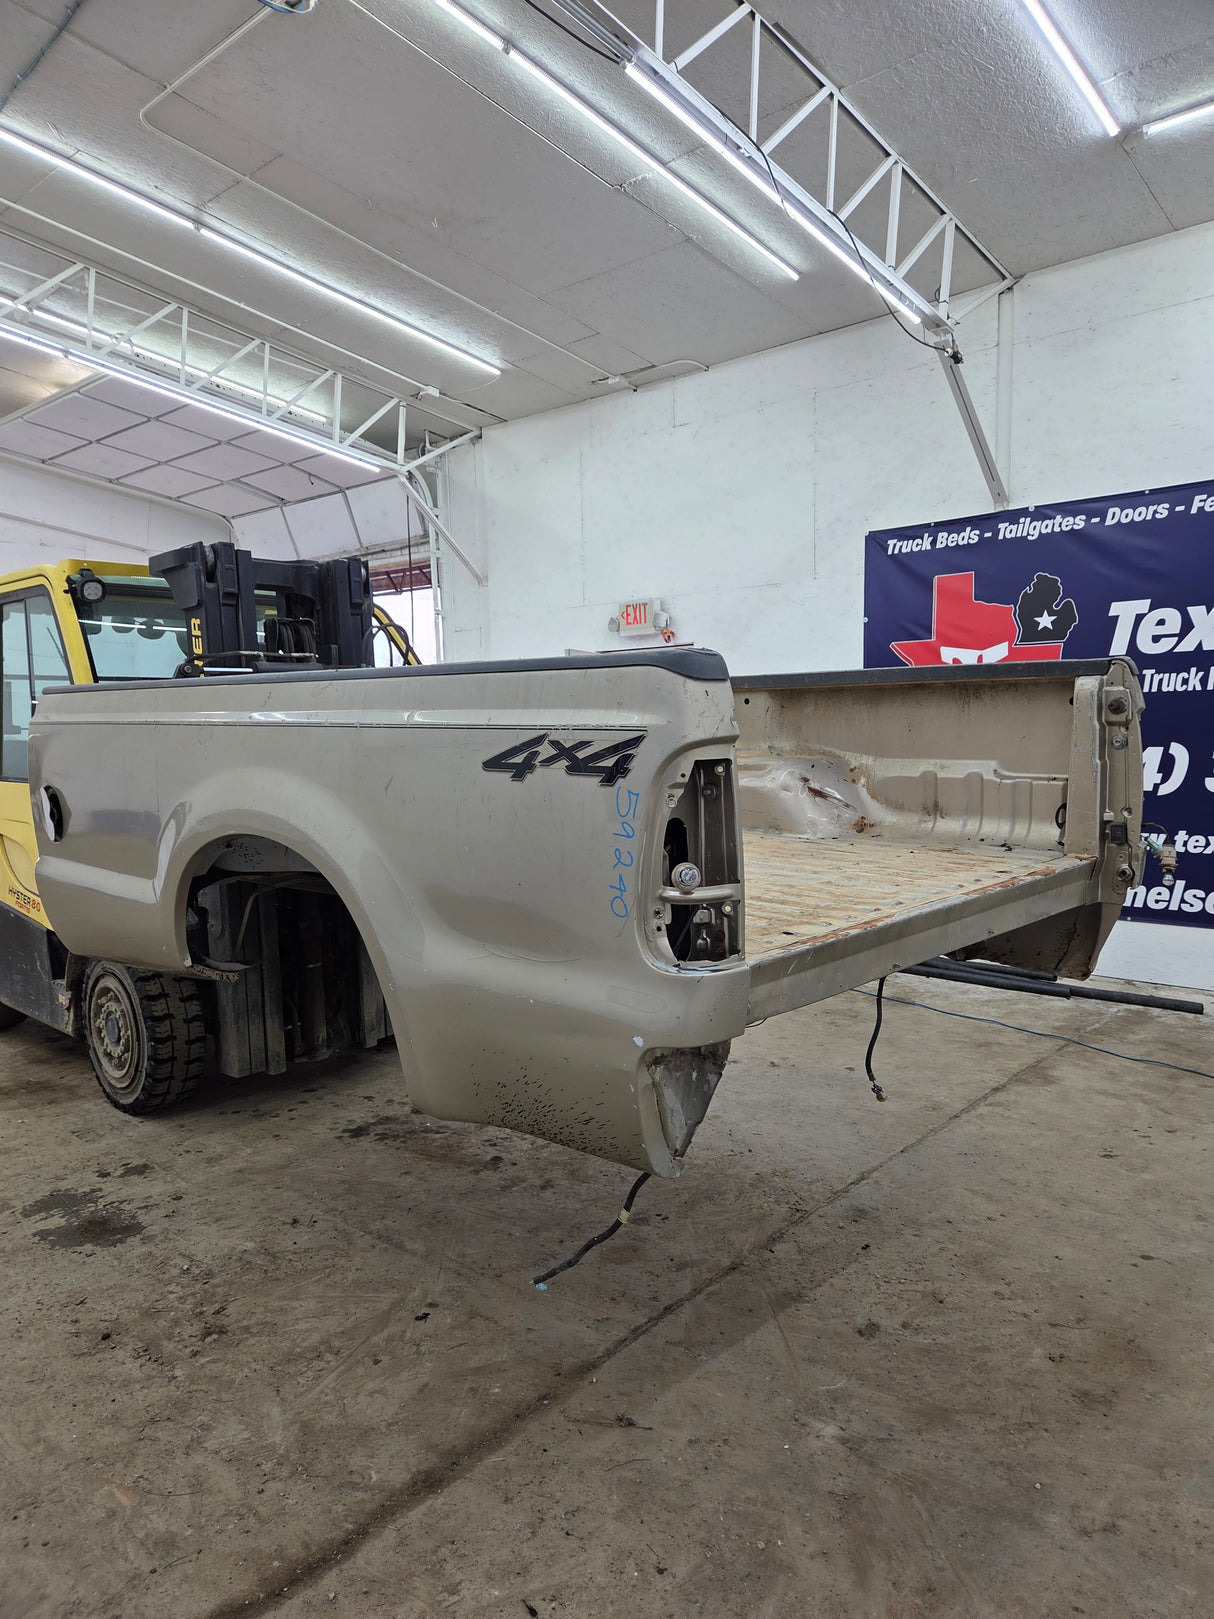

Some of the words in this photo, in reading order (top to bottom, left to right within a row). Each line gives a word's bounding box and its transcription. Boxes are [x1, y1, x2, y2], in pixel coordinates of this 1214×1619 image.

[887, 533, 932, 555] Truck
[935, 526, 980, 549] Beds
[997, 514, 1086, 541] Tailgates
[1104, 503, 1170, 526] Doors
[625, 602, 648, 626] EXIT
[1108, 598, 1214, 656] Tex
[1142, 667, 1205, 693] Truck
[609, 786, 640, 918] 59240
[8, 885, 31, 907] HYSTER
[31, 899, 41, 912] 80
